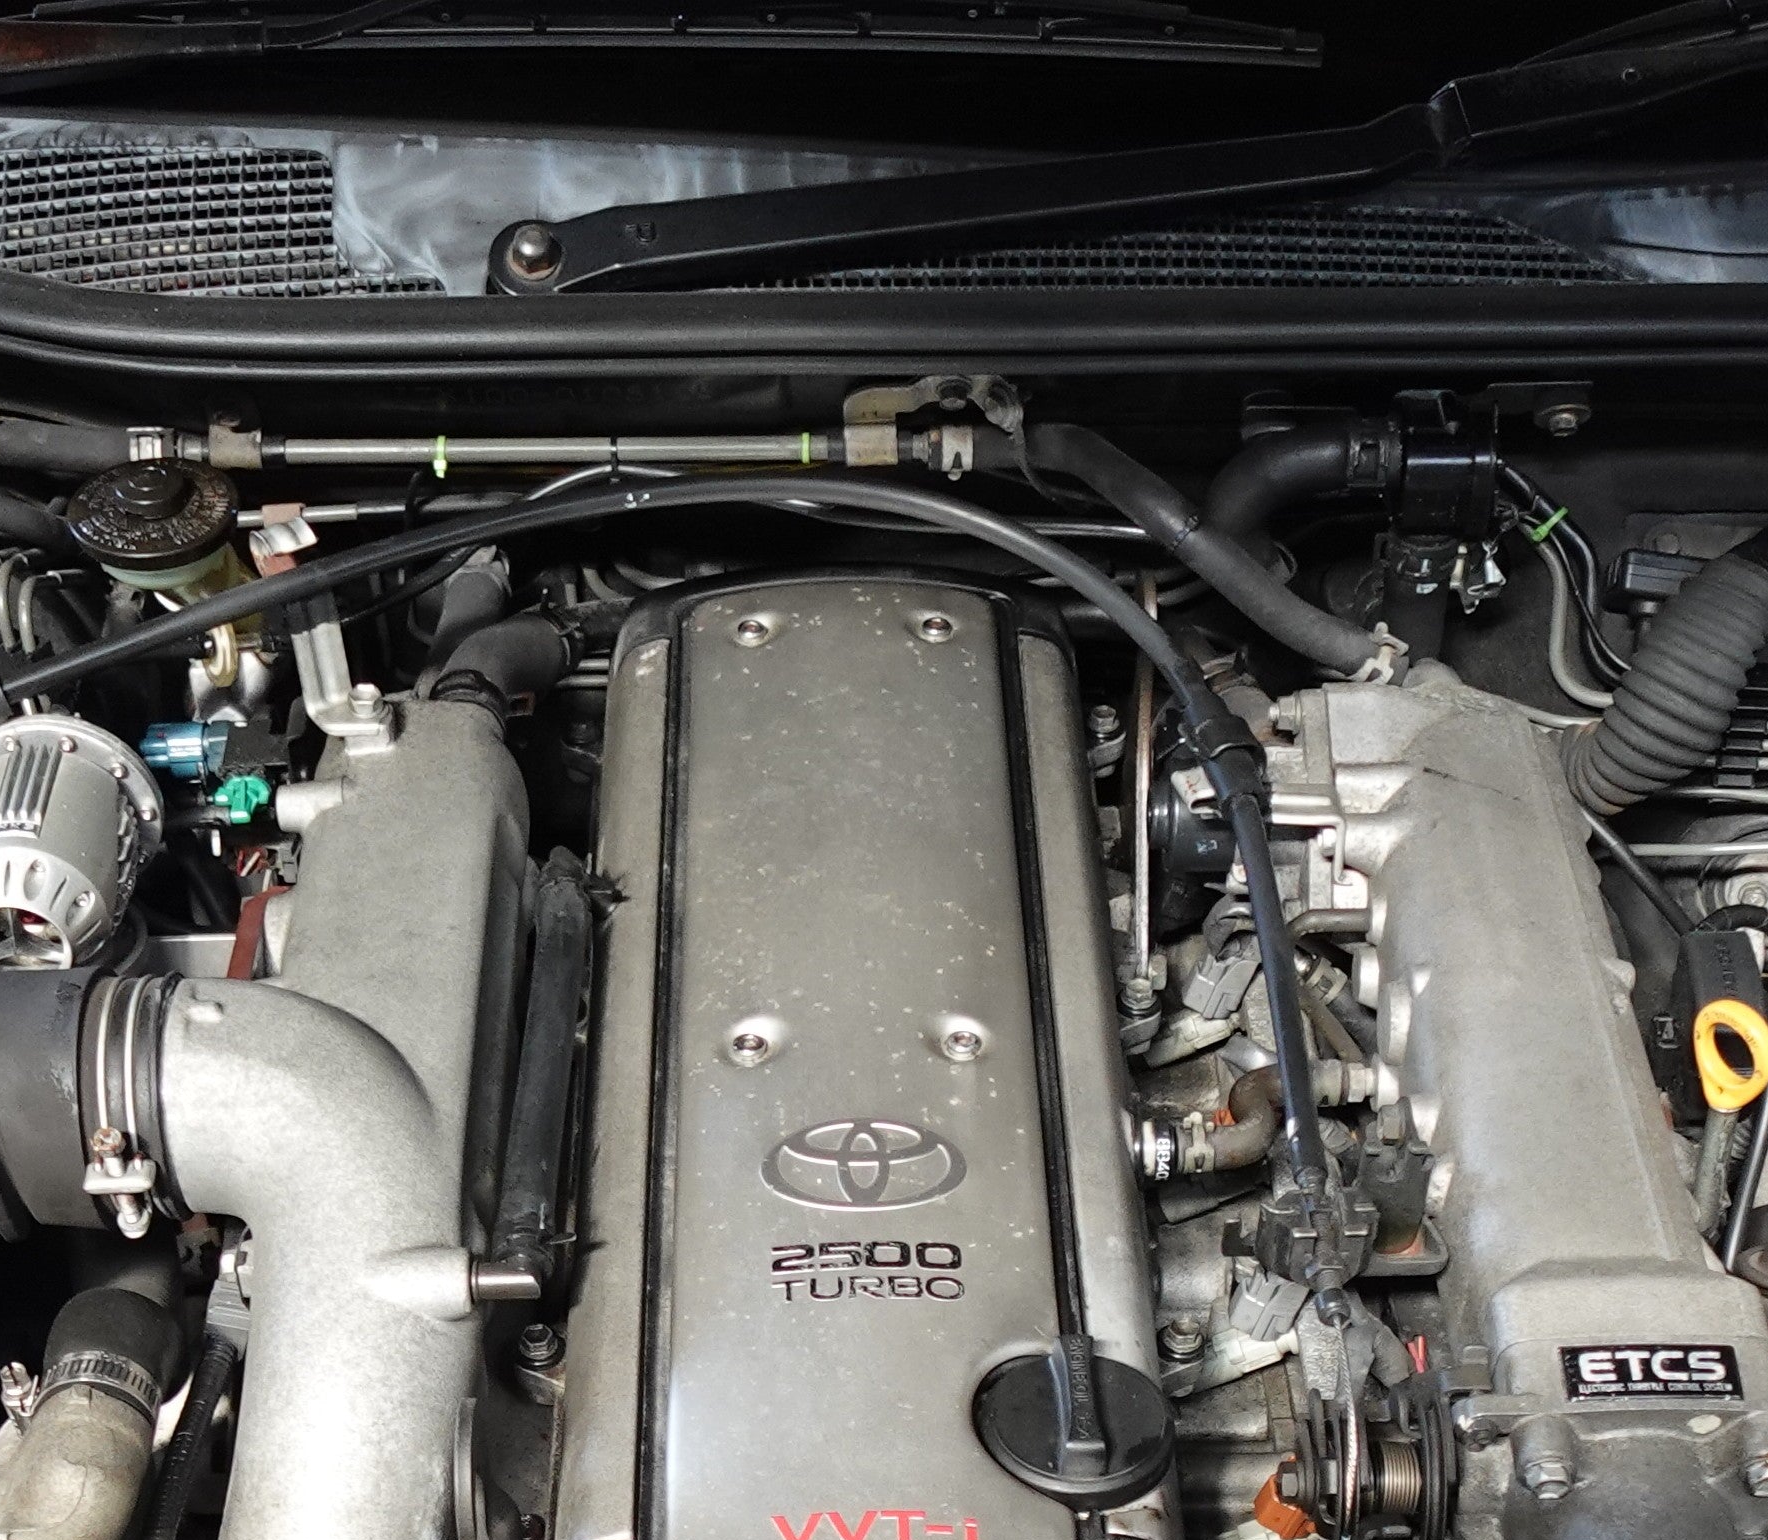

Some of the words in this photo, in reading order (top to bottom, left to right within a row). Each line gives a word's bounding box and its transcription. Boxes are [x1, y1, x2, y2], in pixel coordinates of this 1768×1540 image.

[772, 1241, 962, 1272] 2500
[772, 1276, 964, 1301] TURBO
[1578, 1350, 1726, 1382] ETCS
